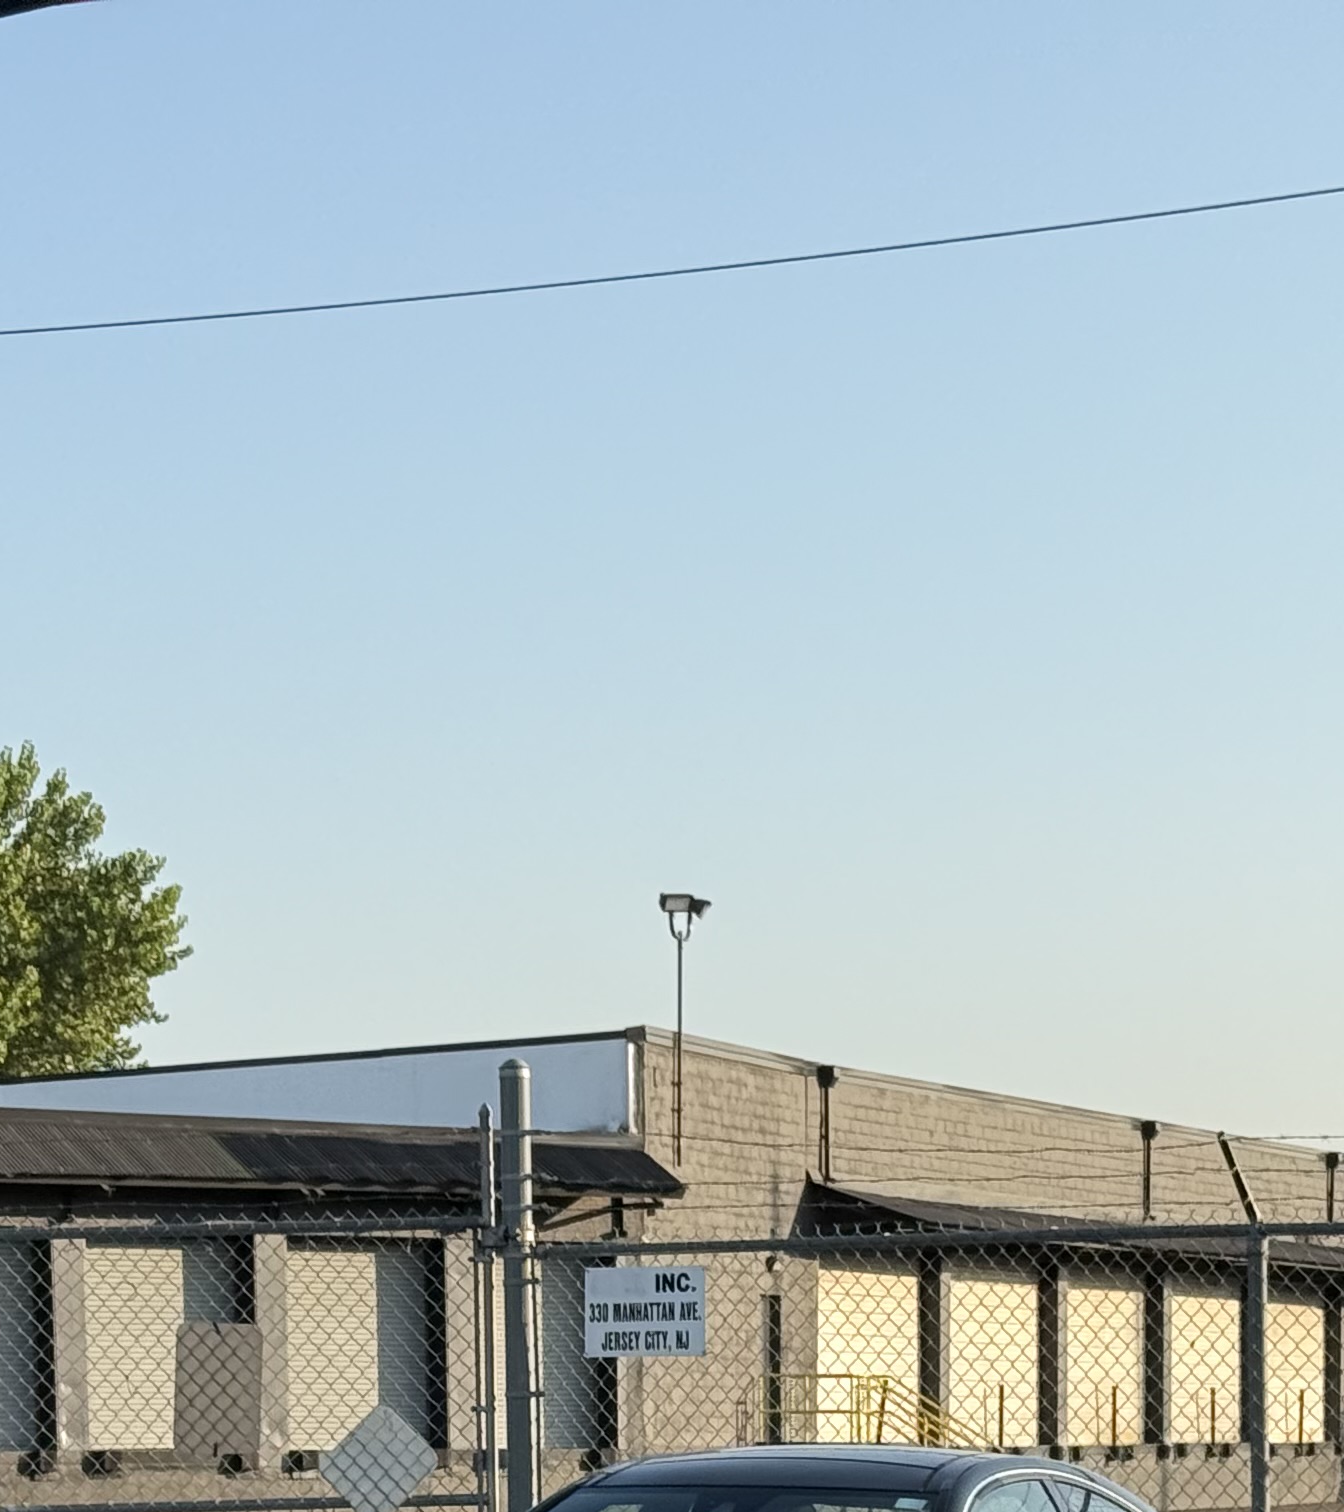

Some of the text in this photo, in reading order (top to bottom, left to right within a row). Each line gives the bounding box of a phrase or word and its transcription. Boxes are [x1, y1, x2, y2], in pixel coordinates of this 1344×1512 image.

[655, 1272, 697, 1293] INC.
[589, 1301, 702, 1323] 330 MANHATTAN AVE.
[601, 1330, 690, 1352] JERSEY CITY, NJ
